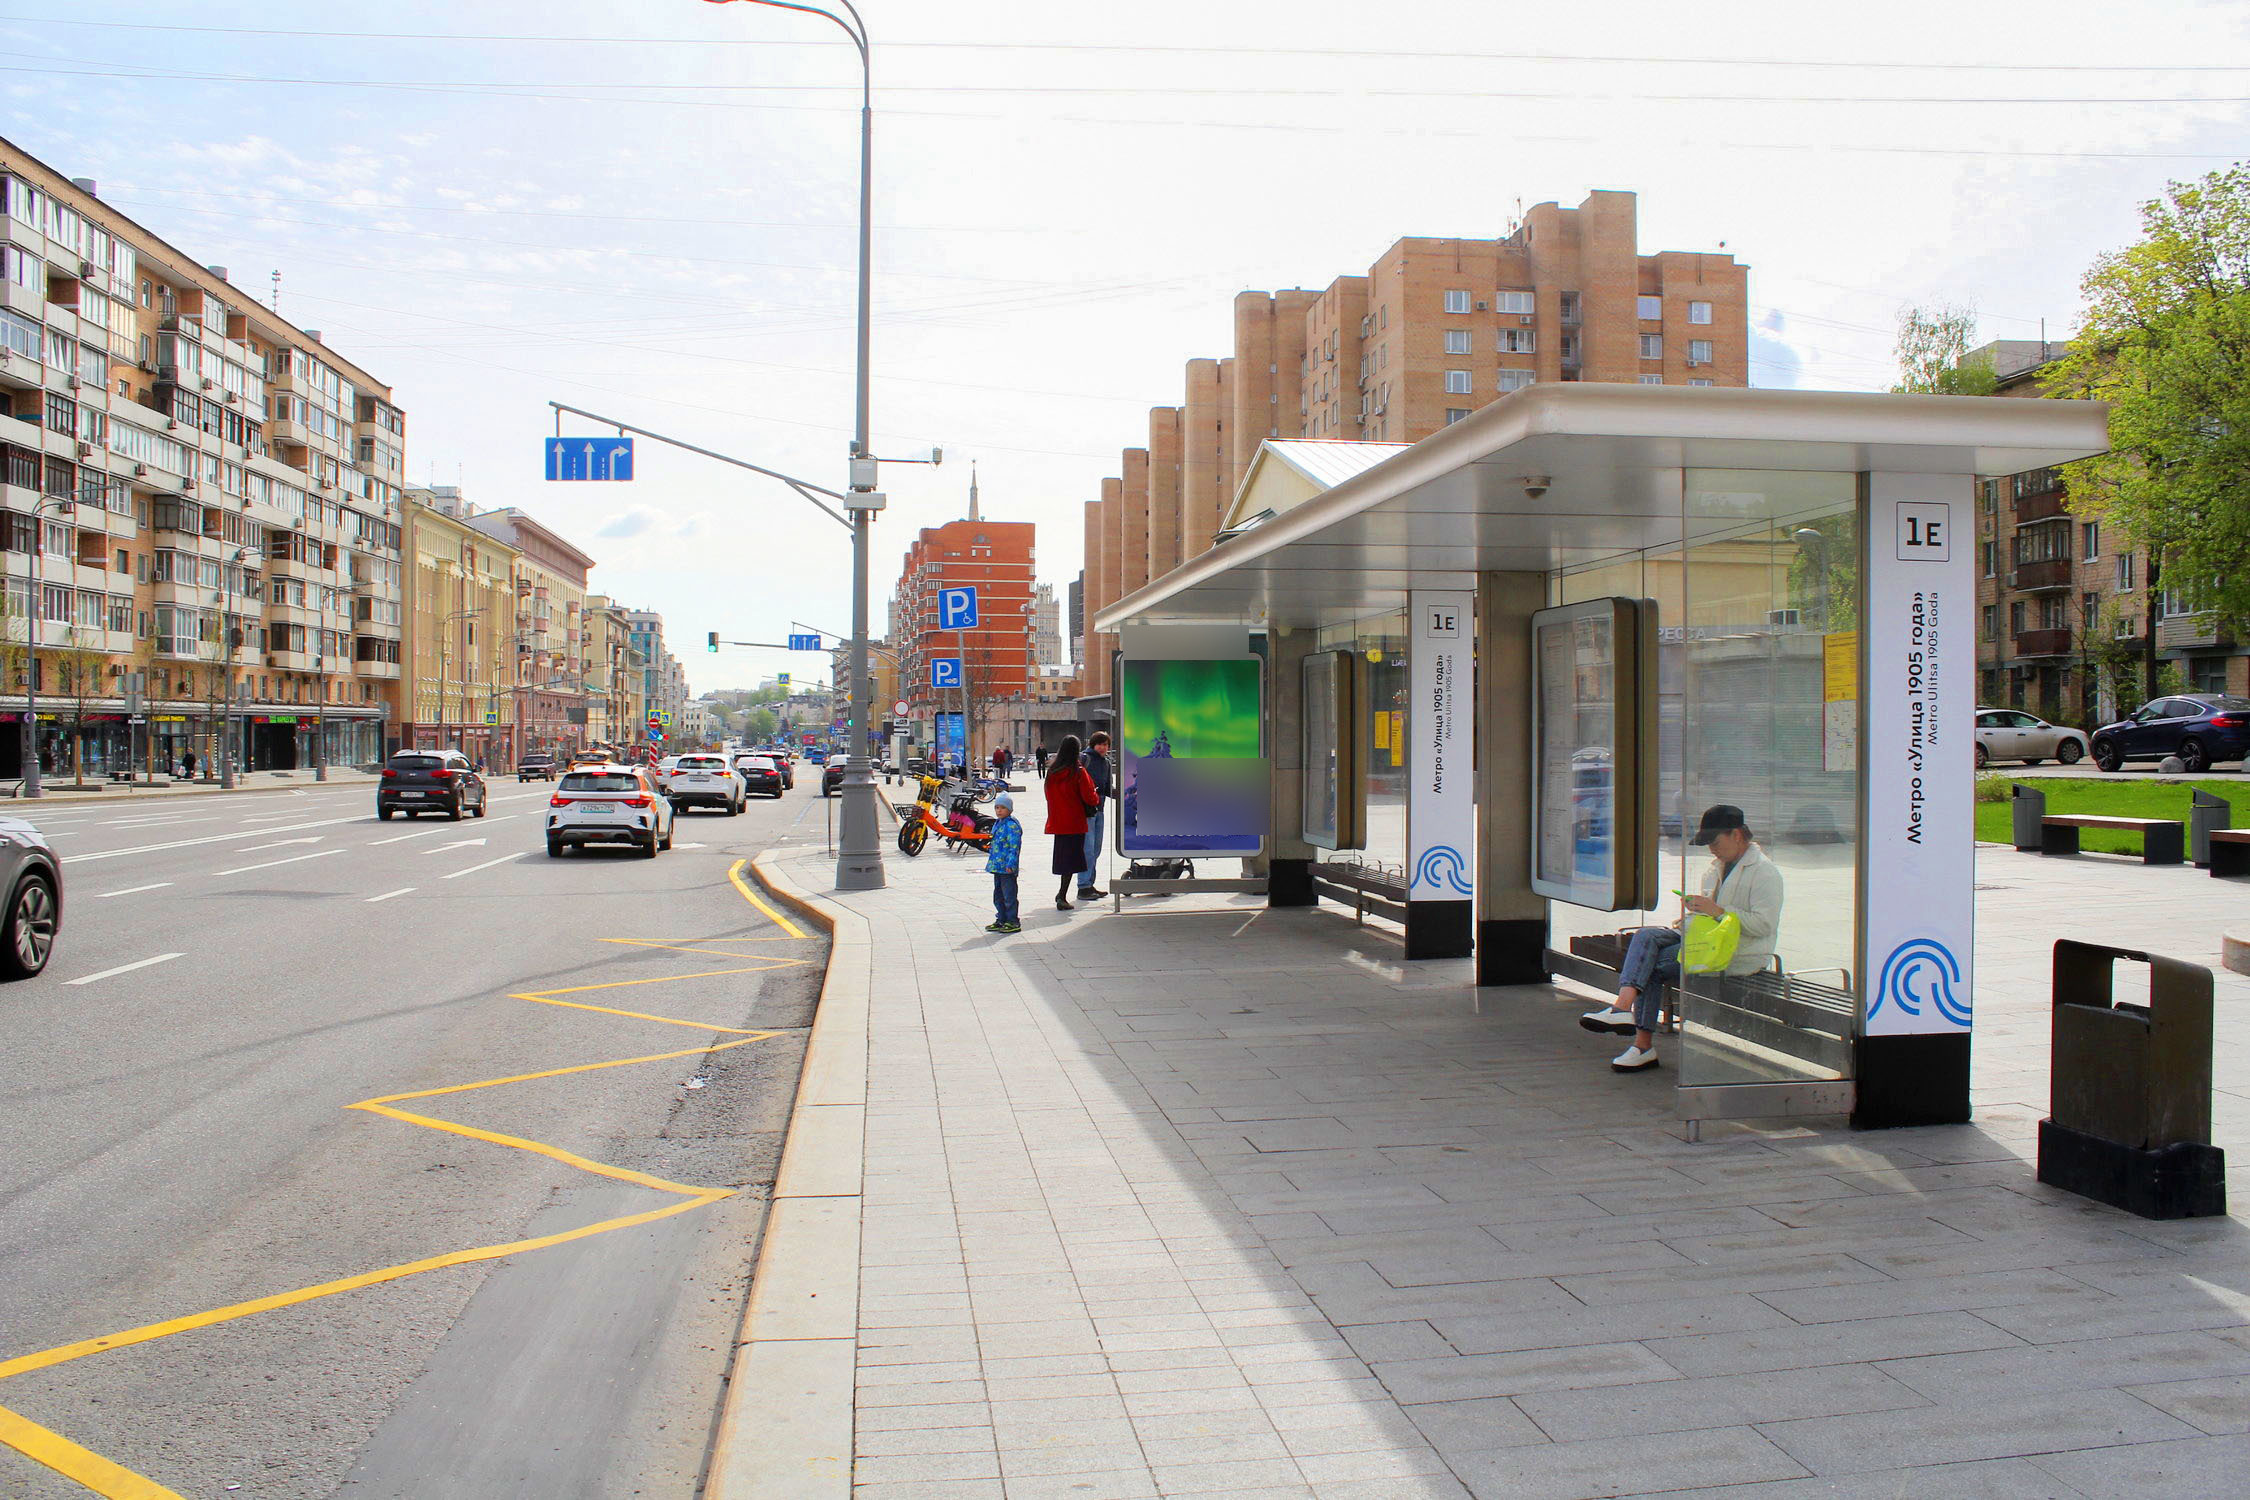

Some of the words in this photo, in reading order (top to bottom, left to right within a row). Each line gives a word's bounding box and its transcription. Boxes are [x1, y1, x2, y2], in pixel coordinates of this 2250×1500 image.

[1906, 517, 1942, 547] 1E
[946, 590, 969, 626] P
[1433, 613, 1455, 631] 1E
[1912, 591, 1925, 646] года»
[1927, 592, 1938, 628] Goda
[1927, 630, 1938, 659] 1905
[1436, 655, 1444, 685] года»
[1445, 655, 1453, 675] Goda
[1908, 651, 1923, 696] 1905
[1927, 663, 1938, 701] Ulitsa
[1433, 687, 1443, 713] 1905
[1445, 676, 1453, 692] 1905
[1445, 693, 1453, 716] Ulitsa
[1433, 715, 1444, 754] «Улица
[1445, 716, 1453, 740] Metro
[1908, 702, 1925, 772] «Улица
[1927, 704, 1938, 745] Metro
[1433, 756, 1444, 794] Метро
[1906, 777, 1925, 844] Метро
